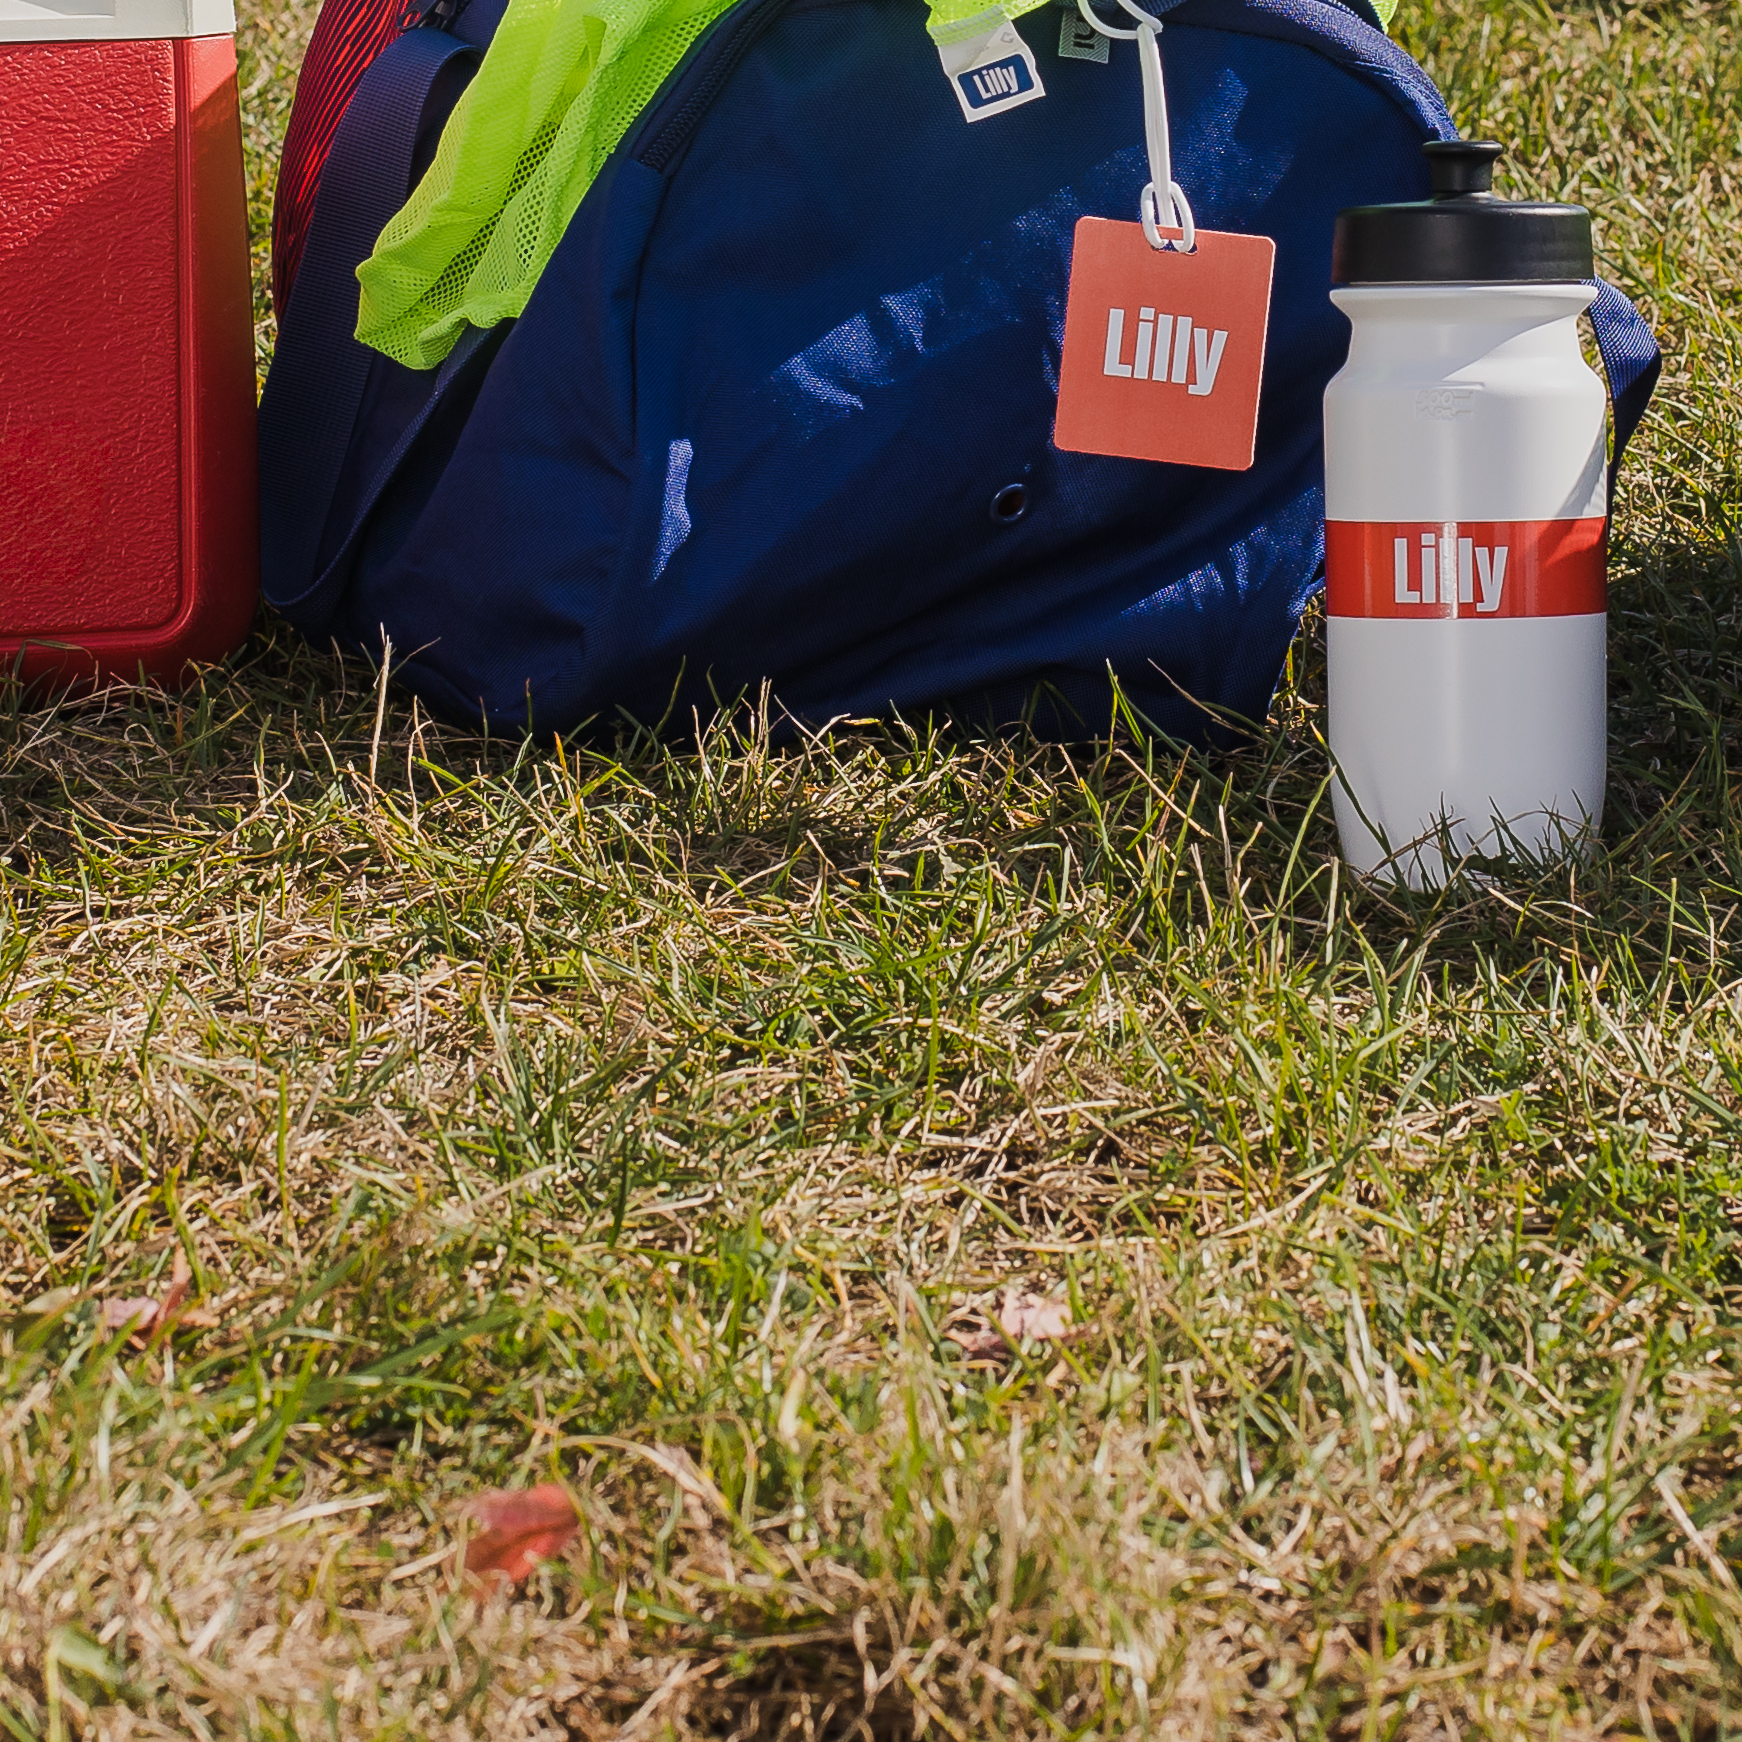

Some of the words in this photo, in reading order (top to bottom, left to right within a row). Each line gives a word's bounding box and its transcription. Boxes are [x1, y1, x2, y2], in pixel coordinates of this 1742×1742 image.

[972, 65, 1019, 100] Lilly
[1103, 306, 1229, 396] Lilly
[1394, 532, 1509, 613] Lilly
